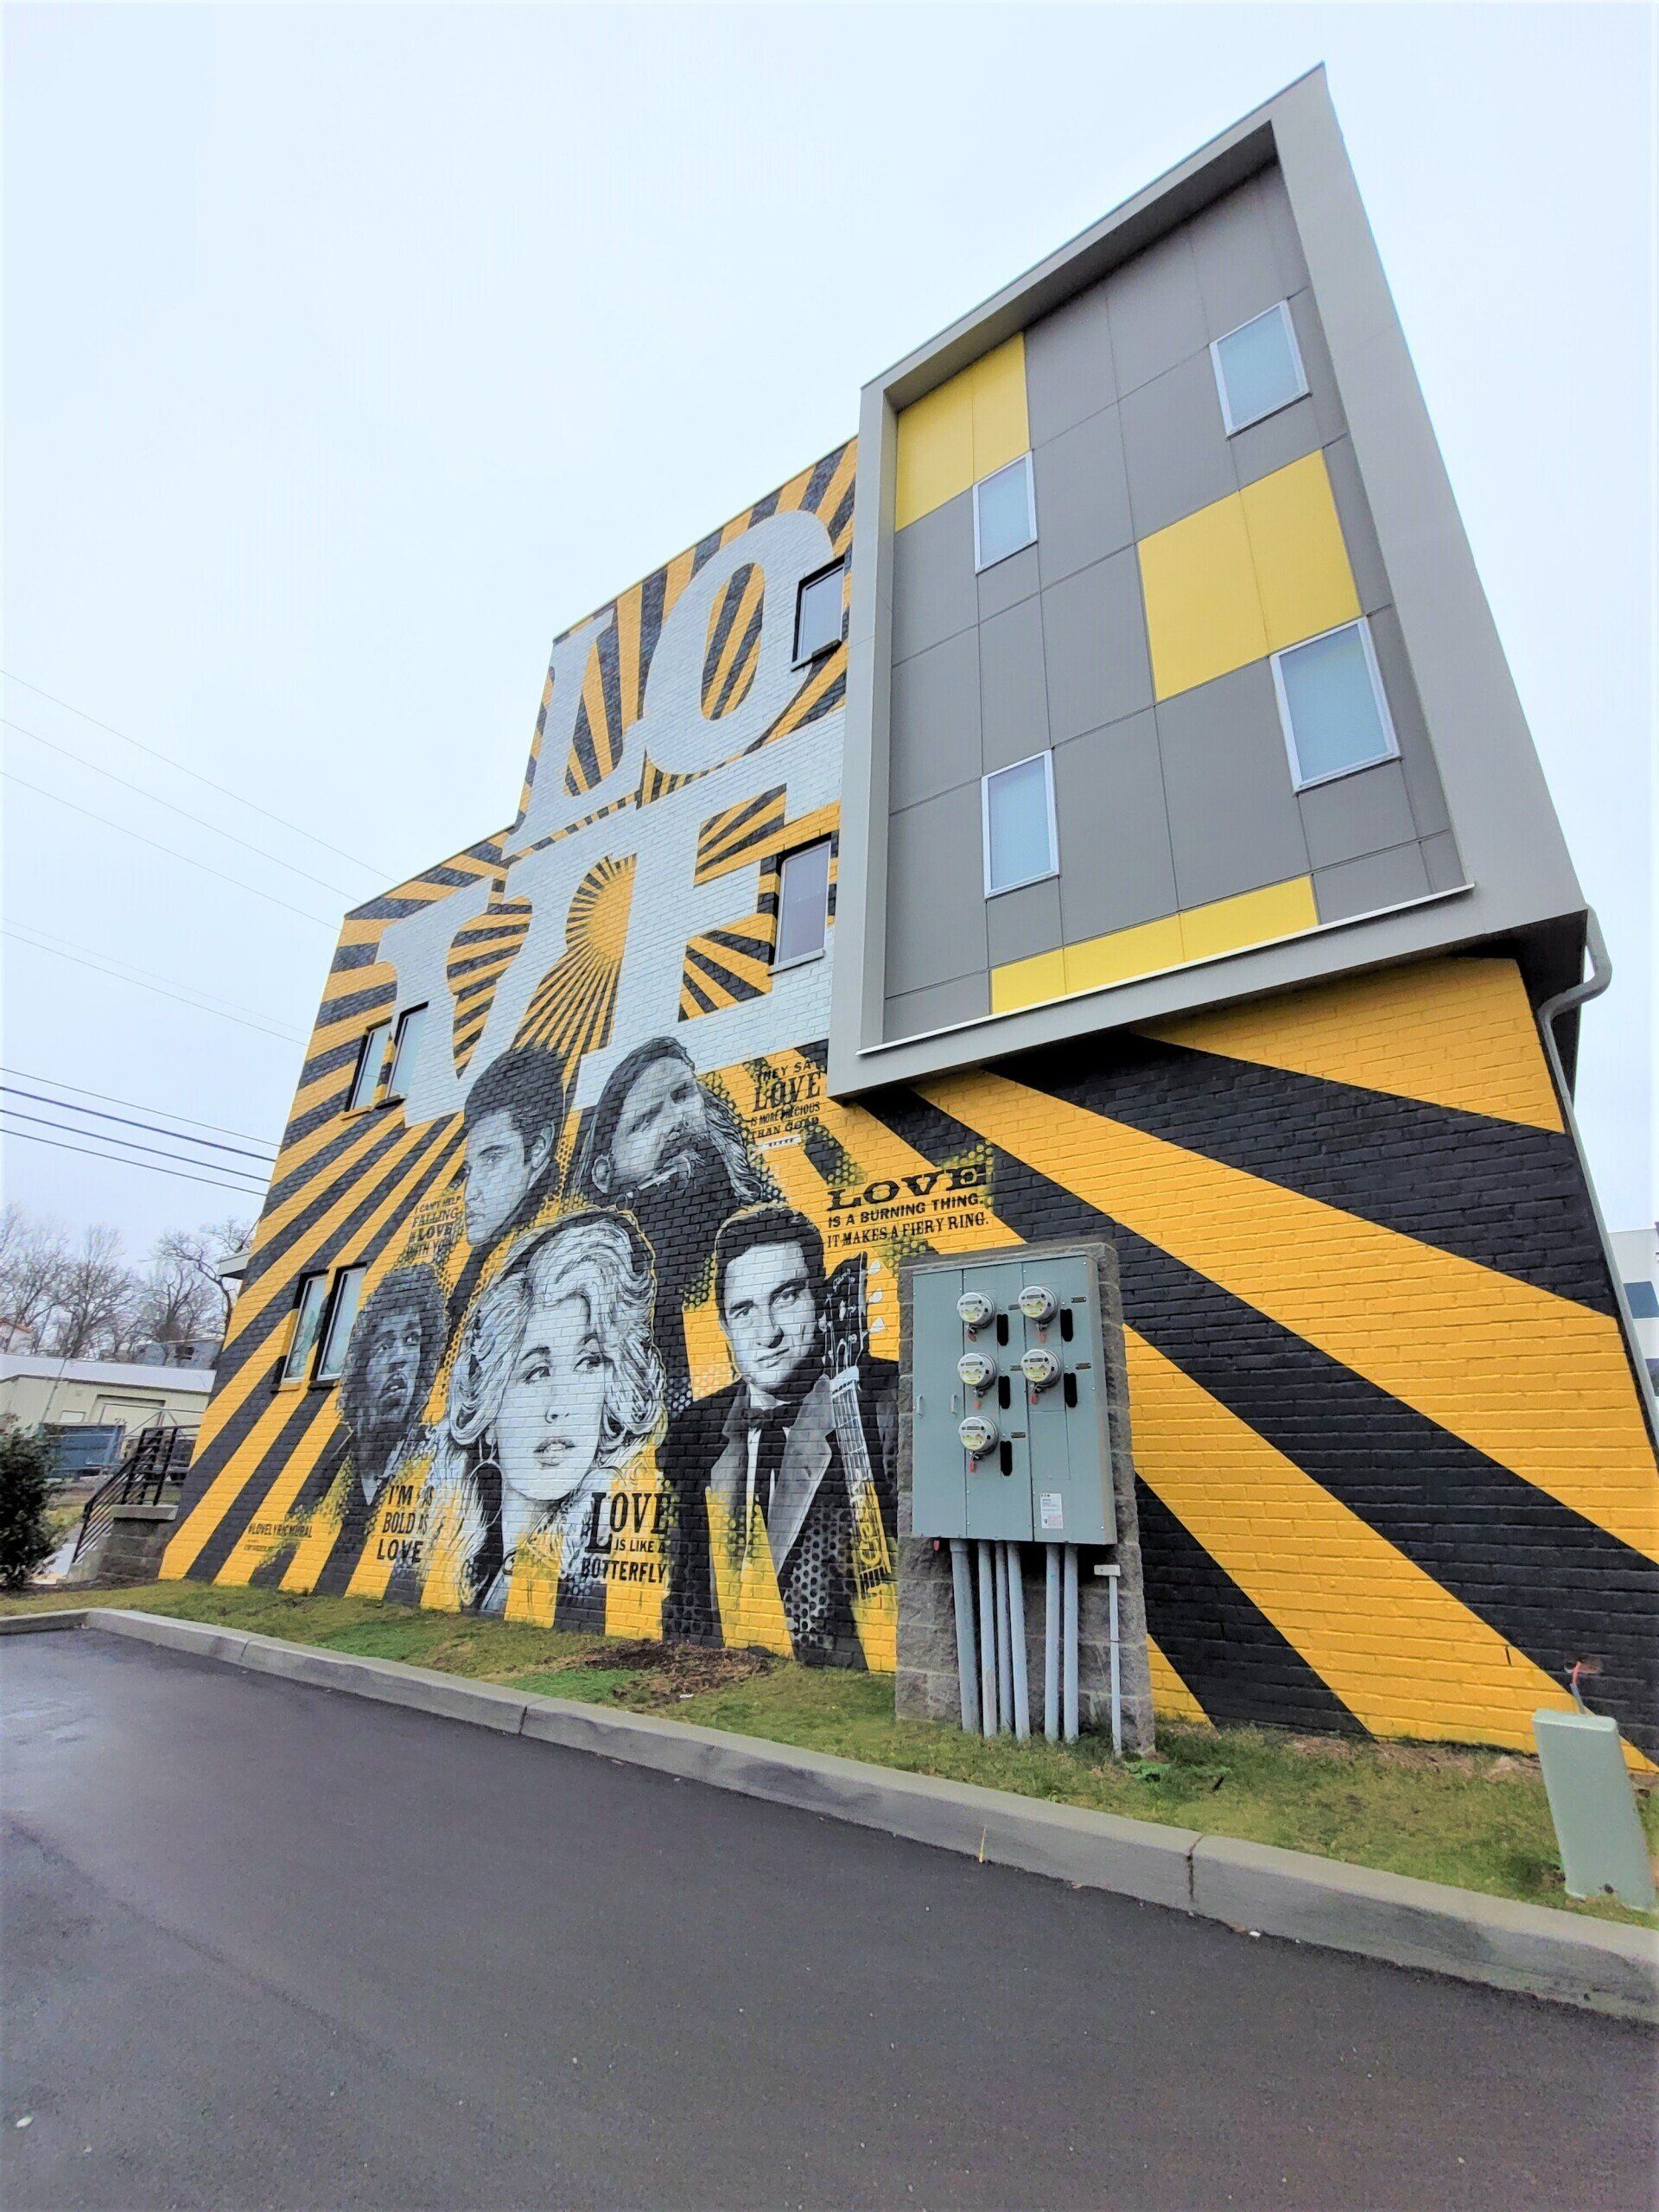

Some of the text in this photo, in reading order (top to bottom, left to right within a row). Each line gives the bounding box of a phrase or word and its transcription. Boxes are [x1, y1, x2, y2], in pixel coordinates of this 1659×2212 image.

[755, 1065, 788, 1084] THEY
[753, 1071, 821, 1112] LOVE
[760, 1109, 779, 1123] MORE
[826, 1164, 988, 1211] LOVE
[828, 1192, 984, 1228] IS A BURNING THING.
[828, 1211, 989, 1248] IT MAKES A FIERY RING.
[388, 1484, 414, 1505] I'M
[382, 1511, 416, 1534] BOLD
[584, 1491, 671, 1554] LOVE
[377, 1538, 424, 1563] LOVE
[614, 1538, 666, 1553] IS LIKE A
